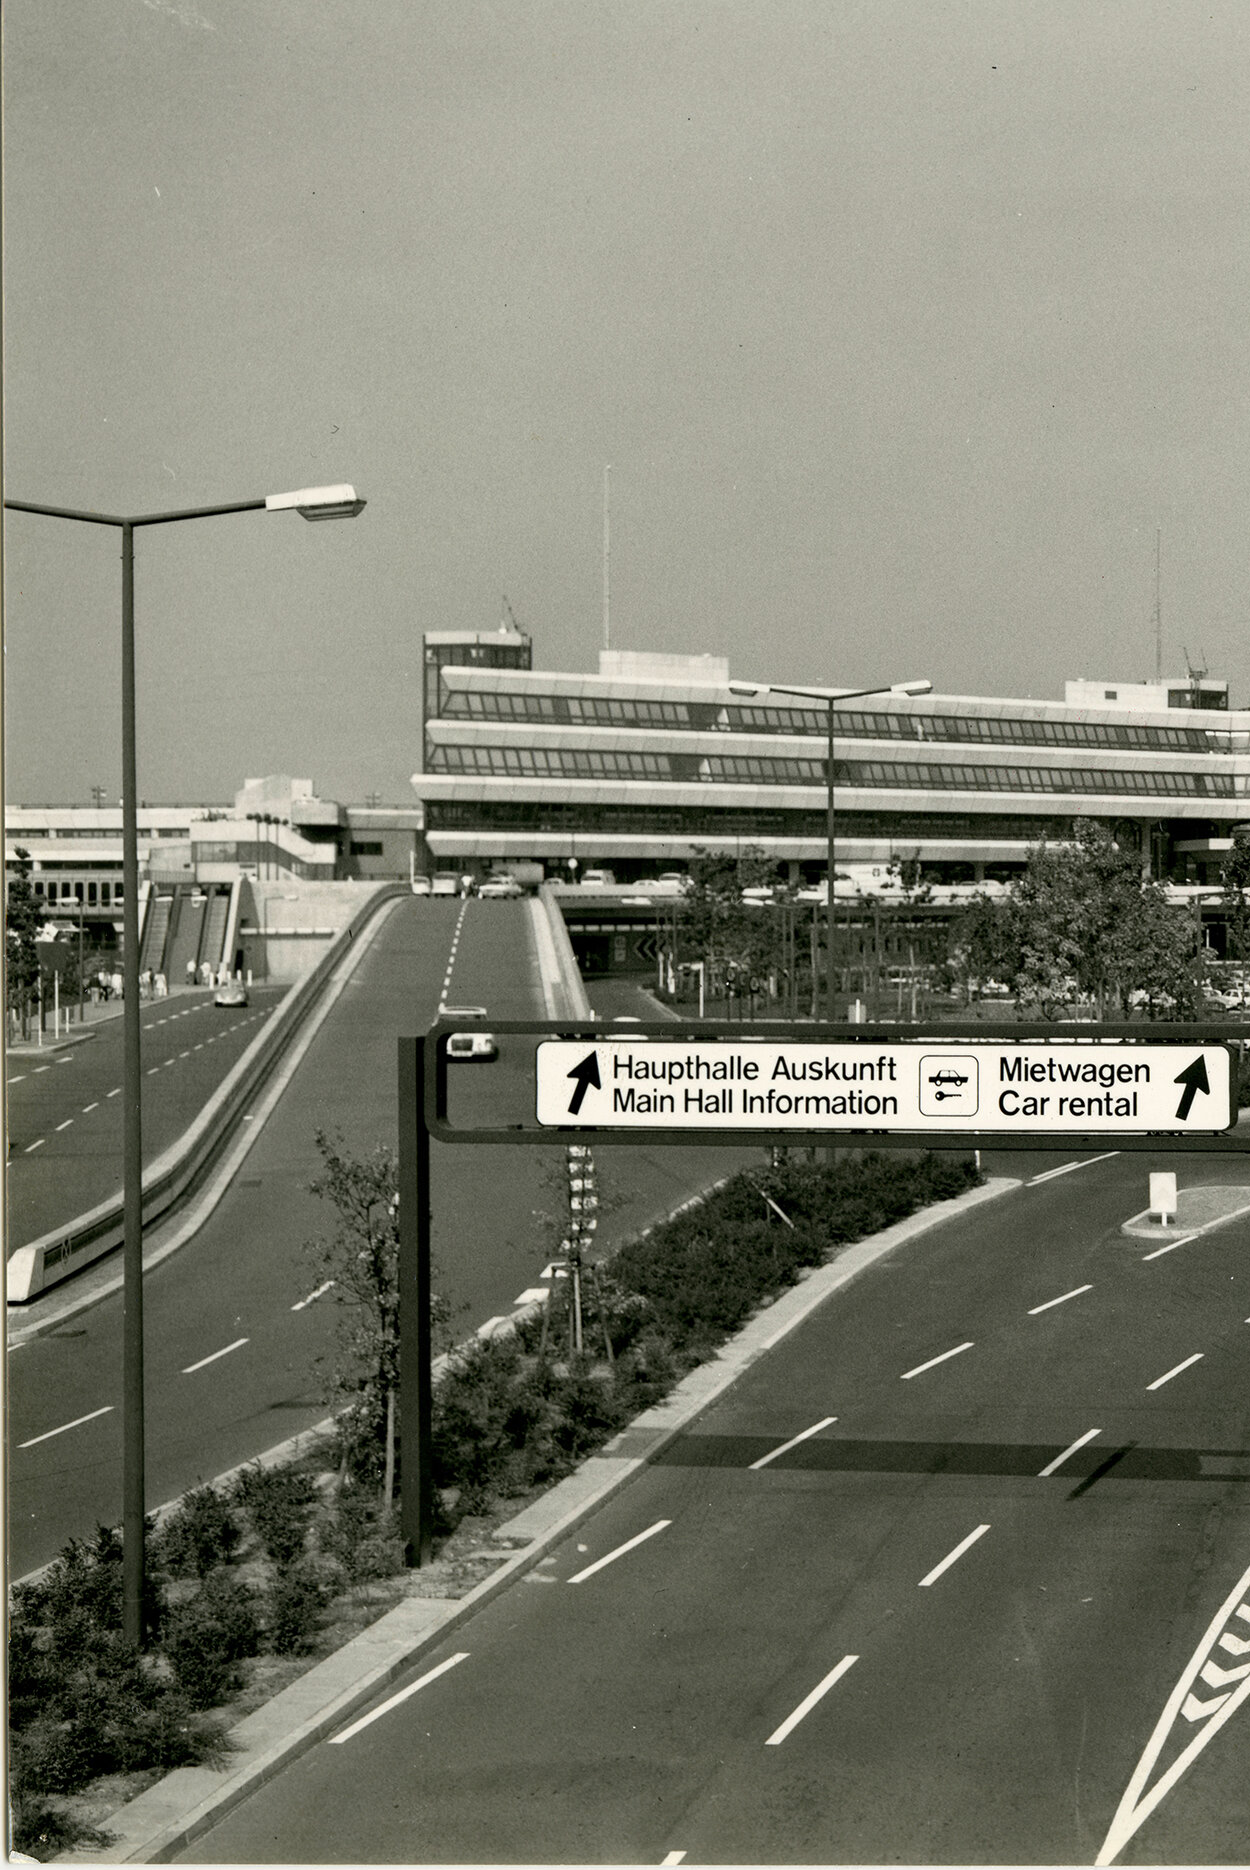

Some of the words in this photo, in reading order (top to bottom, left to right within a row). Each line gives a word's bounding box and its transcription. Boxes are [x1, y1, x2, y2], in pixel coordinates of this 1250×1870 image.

[614, 1055, 759, 1084] Haupthalle
[772, 1056, 896, 1081] Auskunft
[1000, 1057, 1150, 1087] Mietwagen
[614, 1088, 674, 1113] Main
[685, 1089, 732, 1113] Hall
[743, 1089, 897, 1114] Information
[999, 1090, 1050, 1116] Car
[1060, 1092, 1137, 1116] rental
